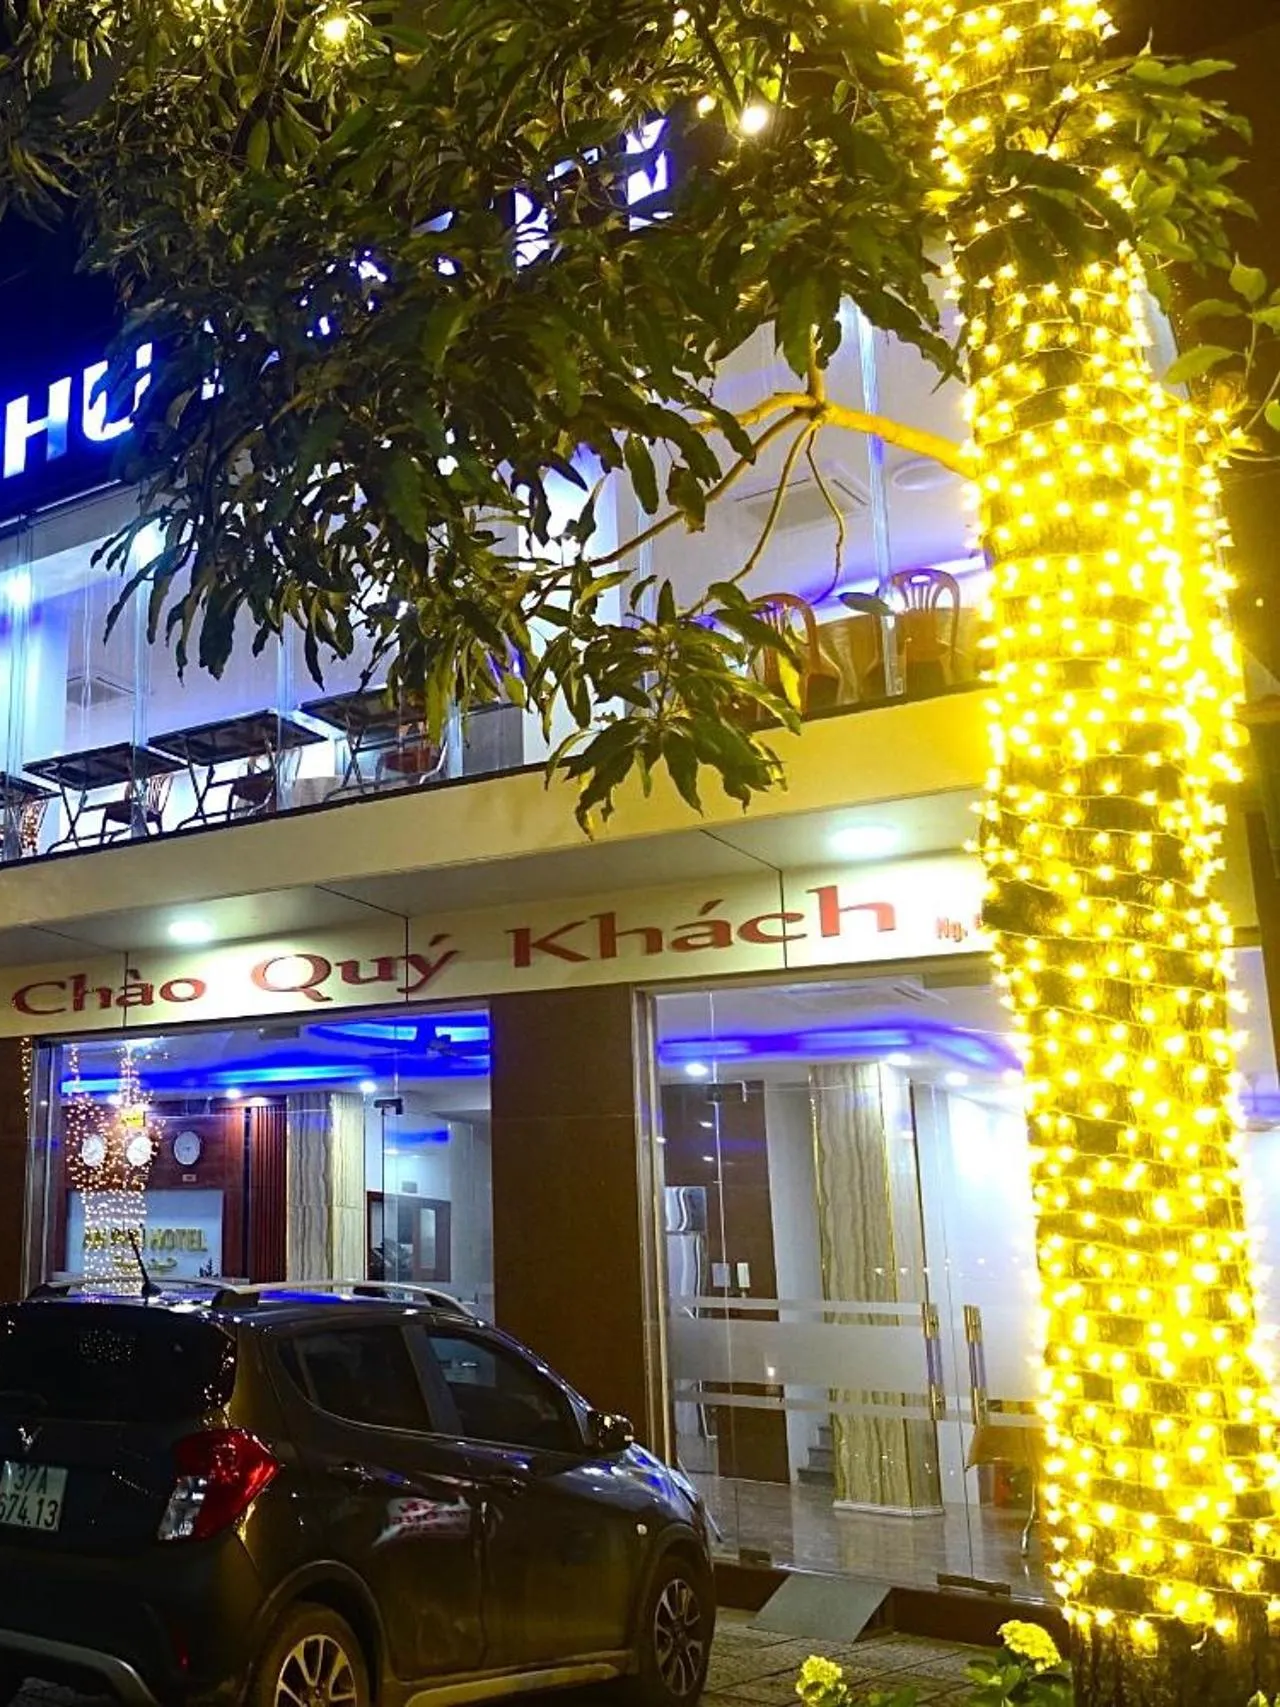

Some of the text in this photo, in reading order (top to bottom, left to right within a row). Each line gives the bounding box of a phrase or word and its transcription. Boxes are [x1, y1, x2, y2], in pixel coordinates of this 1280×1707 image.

[12, 968, 207, 1017] Chào
[250, 933, 459, 1002] Quý
[505, 885, 896, 968] Khách
[13, 1462, 48, 1494] 37A
